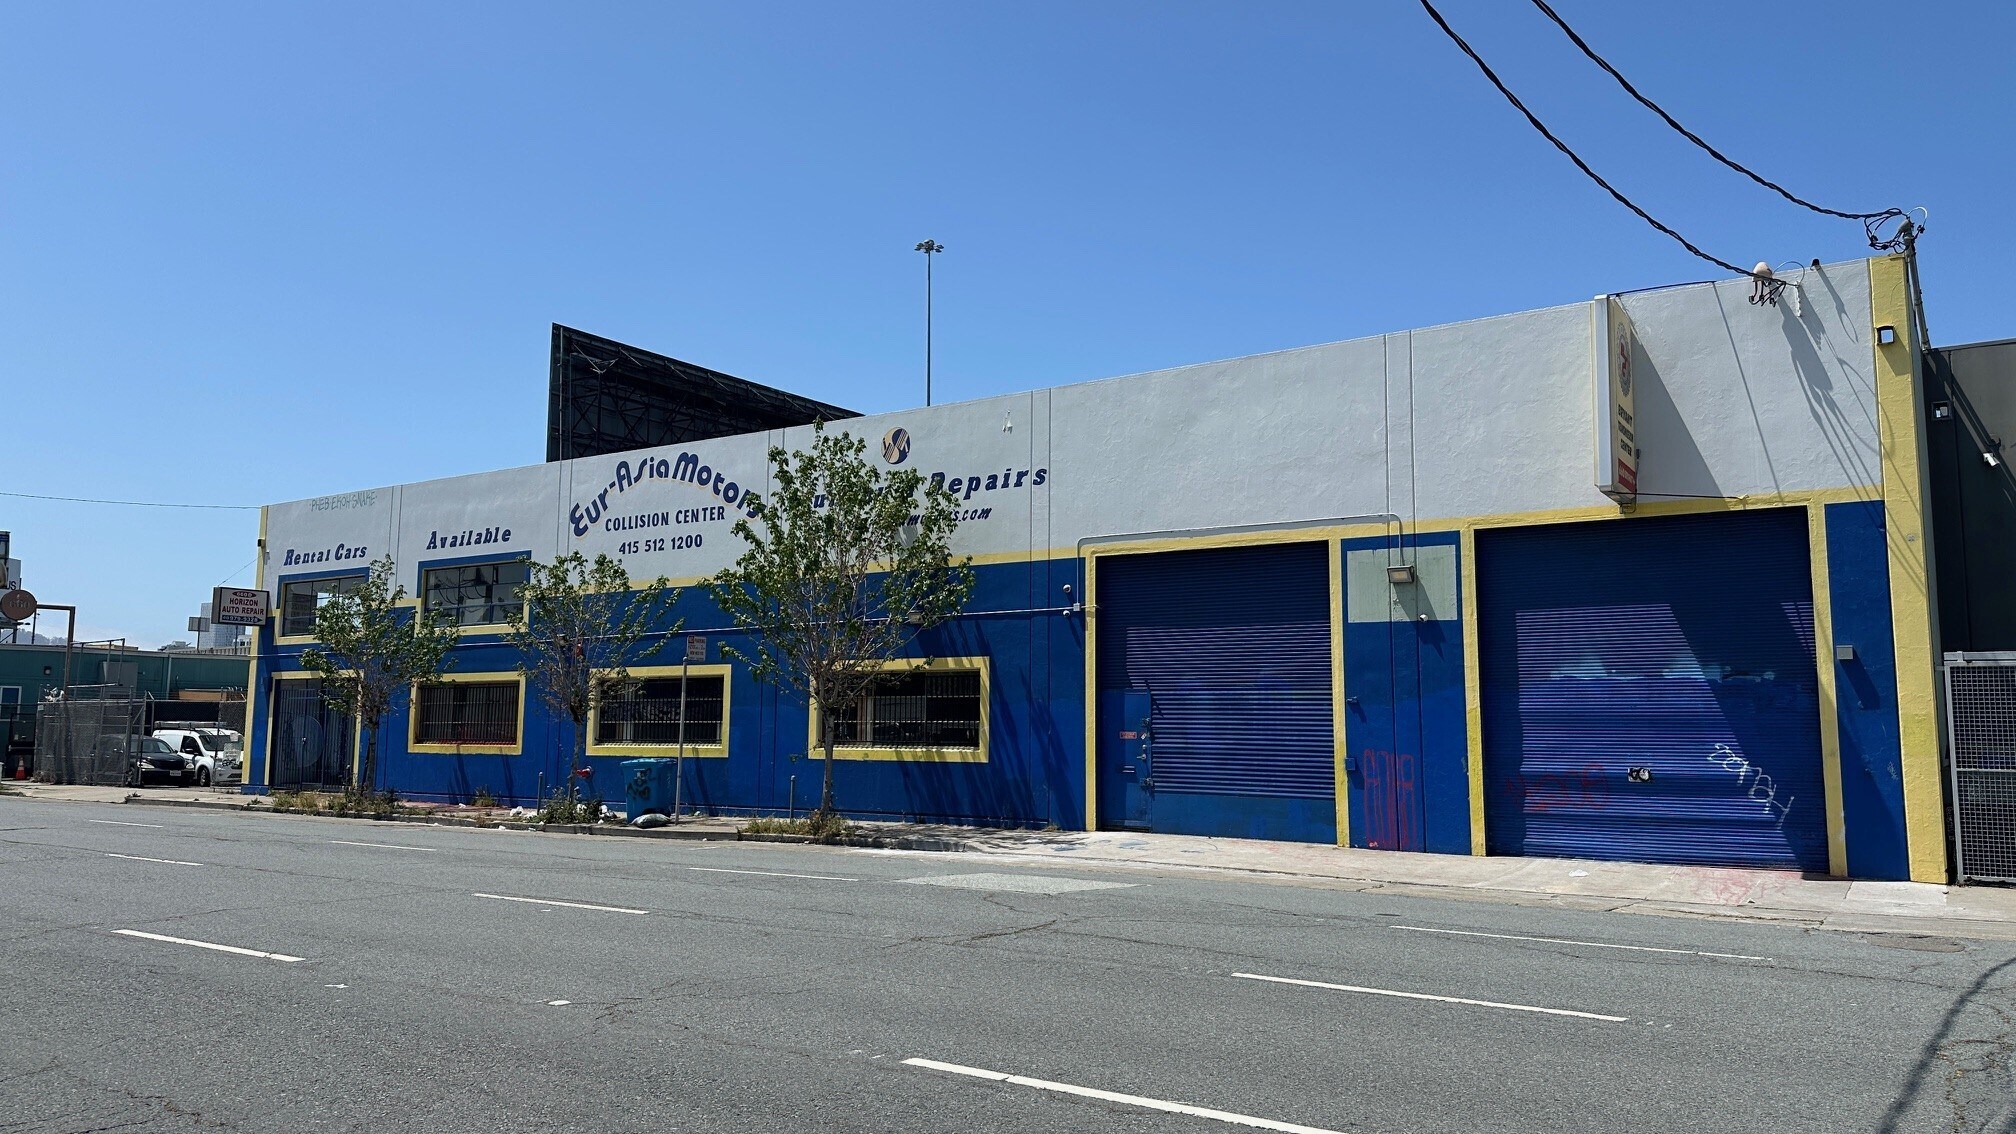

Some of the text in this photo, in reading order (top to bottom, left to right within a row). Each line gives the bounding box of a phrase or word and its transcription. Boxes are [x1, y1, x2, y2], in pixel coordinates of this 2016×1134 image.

[605, 505, 725, 532] COLLISION CENTER
[427, 526, 512, 550] Available
[618, 534, 703, 555] 415 512 1200
[283, 543, 367, 566] Rental Cars
[221, 605, 264, 615] AUTO REPAIR
[229, 598, 259, 607] HORIZON
